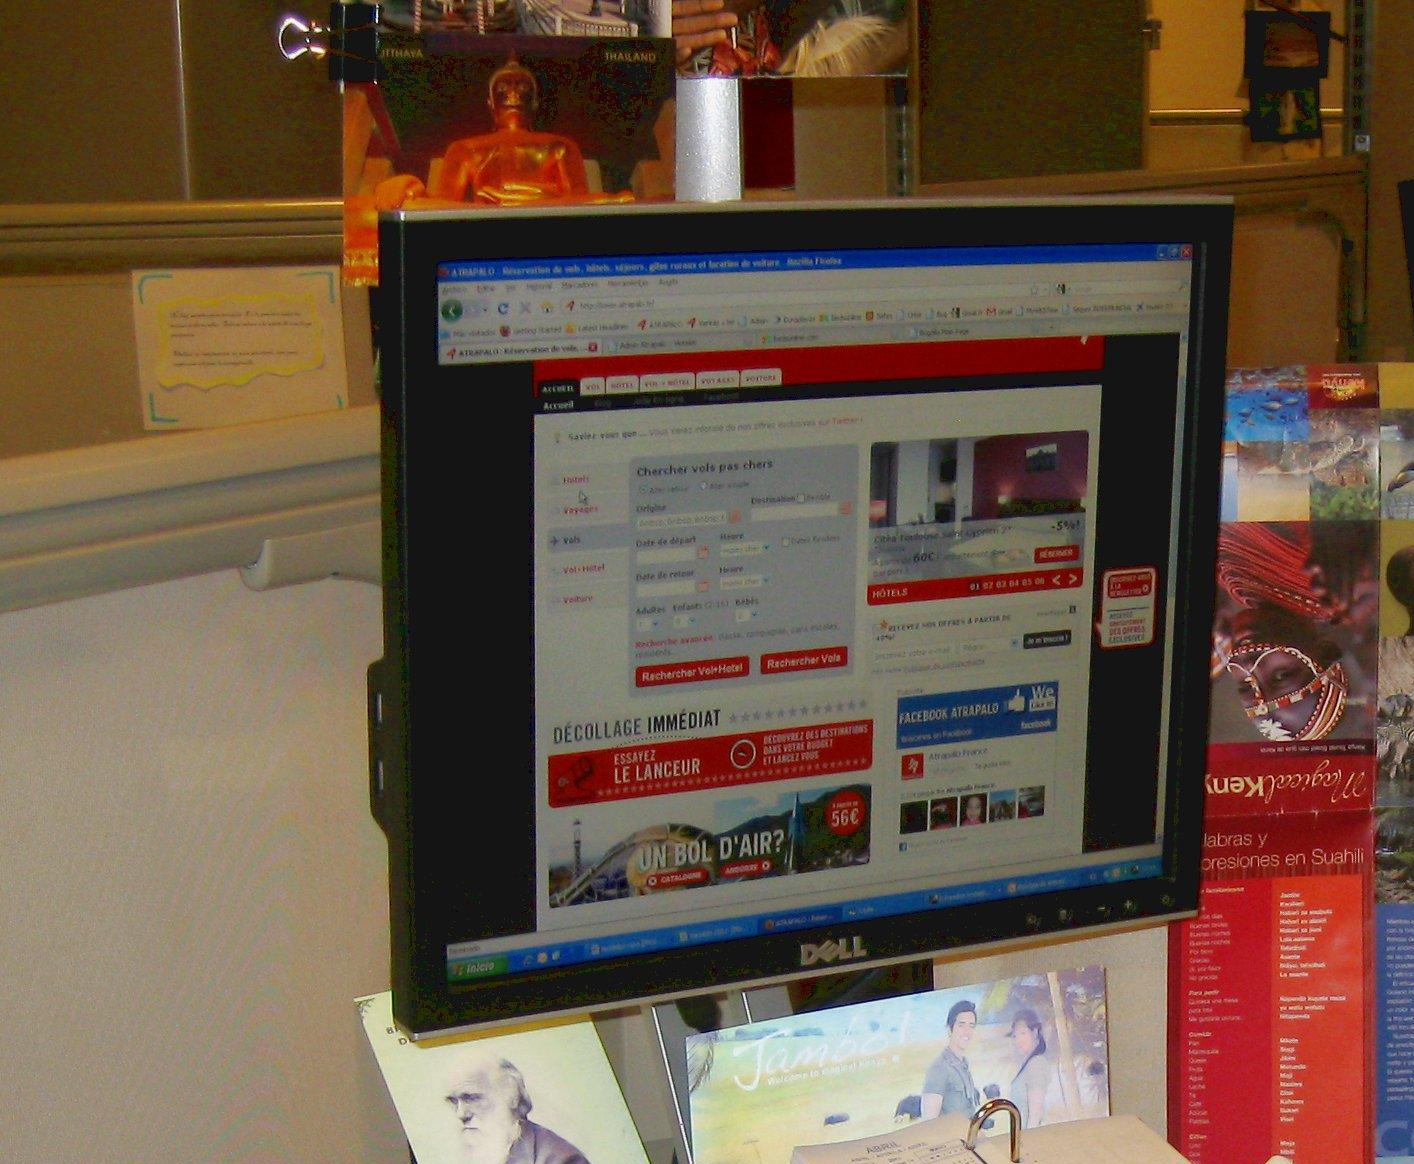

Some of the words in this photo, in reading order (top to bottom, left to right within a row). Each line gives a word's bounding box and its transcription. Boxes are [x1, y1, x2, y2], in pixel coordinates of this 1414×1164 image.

[605, 51, 657, 63] THAILAND
[636, 464, 689, 478] Chercher
[690, 462, 716, 475] vols
[718, 463, 739, 476] pas
[742, 458, 774, 472] chers
[642, 668, 697, 683] Rechercher
[767, 655, 818, 670] Rechercher
[1031, 685, 1055, 699] We
[899, 706, 949, 725] FACEBOOK
[552, 717, 642, 745] DÉCOLLAGE
[647, 708, 722, 734] IMMÉDIAT
[613, 749, 656, 766] ESSAYEZ
[613, 764, 631, 784] LE
[635, 758, 701, 782] LANCEUR
[1264, 758, 1368, 804] Magical
[1203, 773, 1265, 798] Keny
[830, 809, 860, 827] 56€
[639, 847, 667, 871] UN
[675, 841, 711, 866] BOL
[719, 829, 785, 860] D'AIR?
[1203, 831, 1252, 849] labras
[1257, 832, 1269, 849] y
[1285, 853, 1307, 867] en
[1311, 847, 1365, 867] Suahili
[800, 936, 868, 965] DELL
[767, 1070, 808, 1086] Welcome
